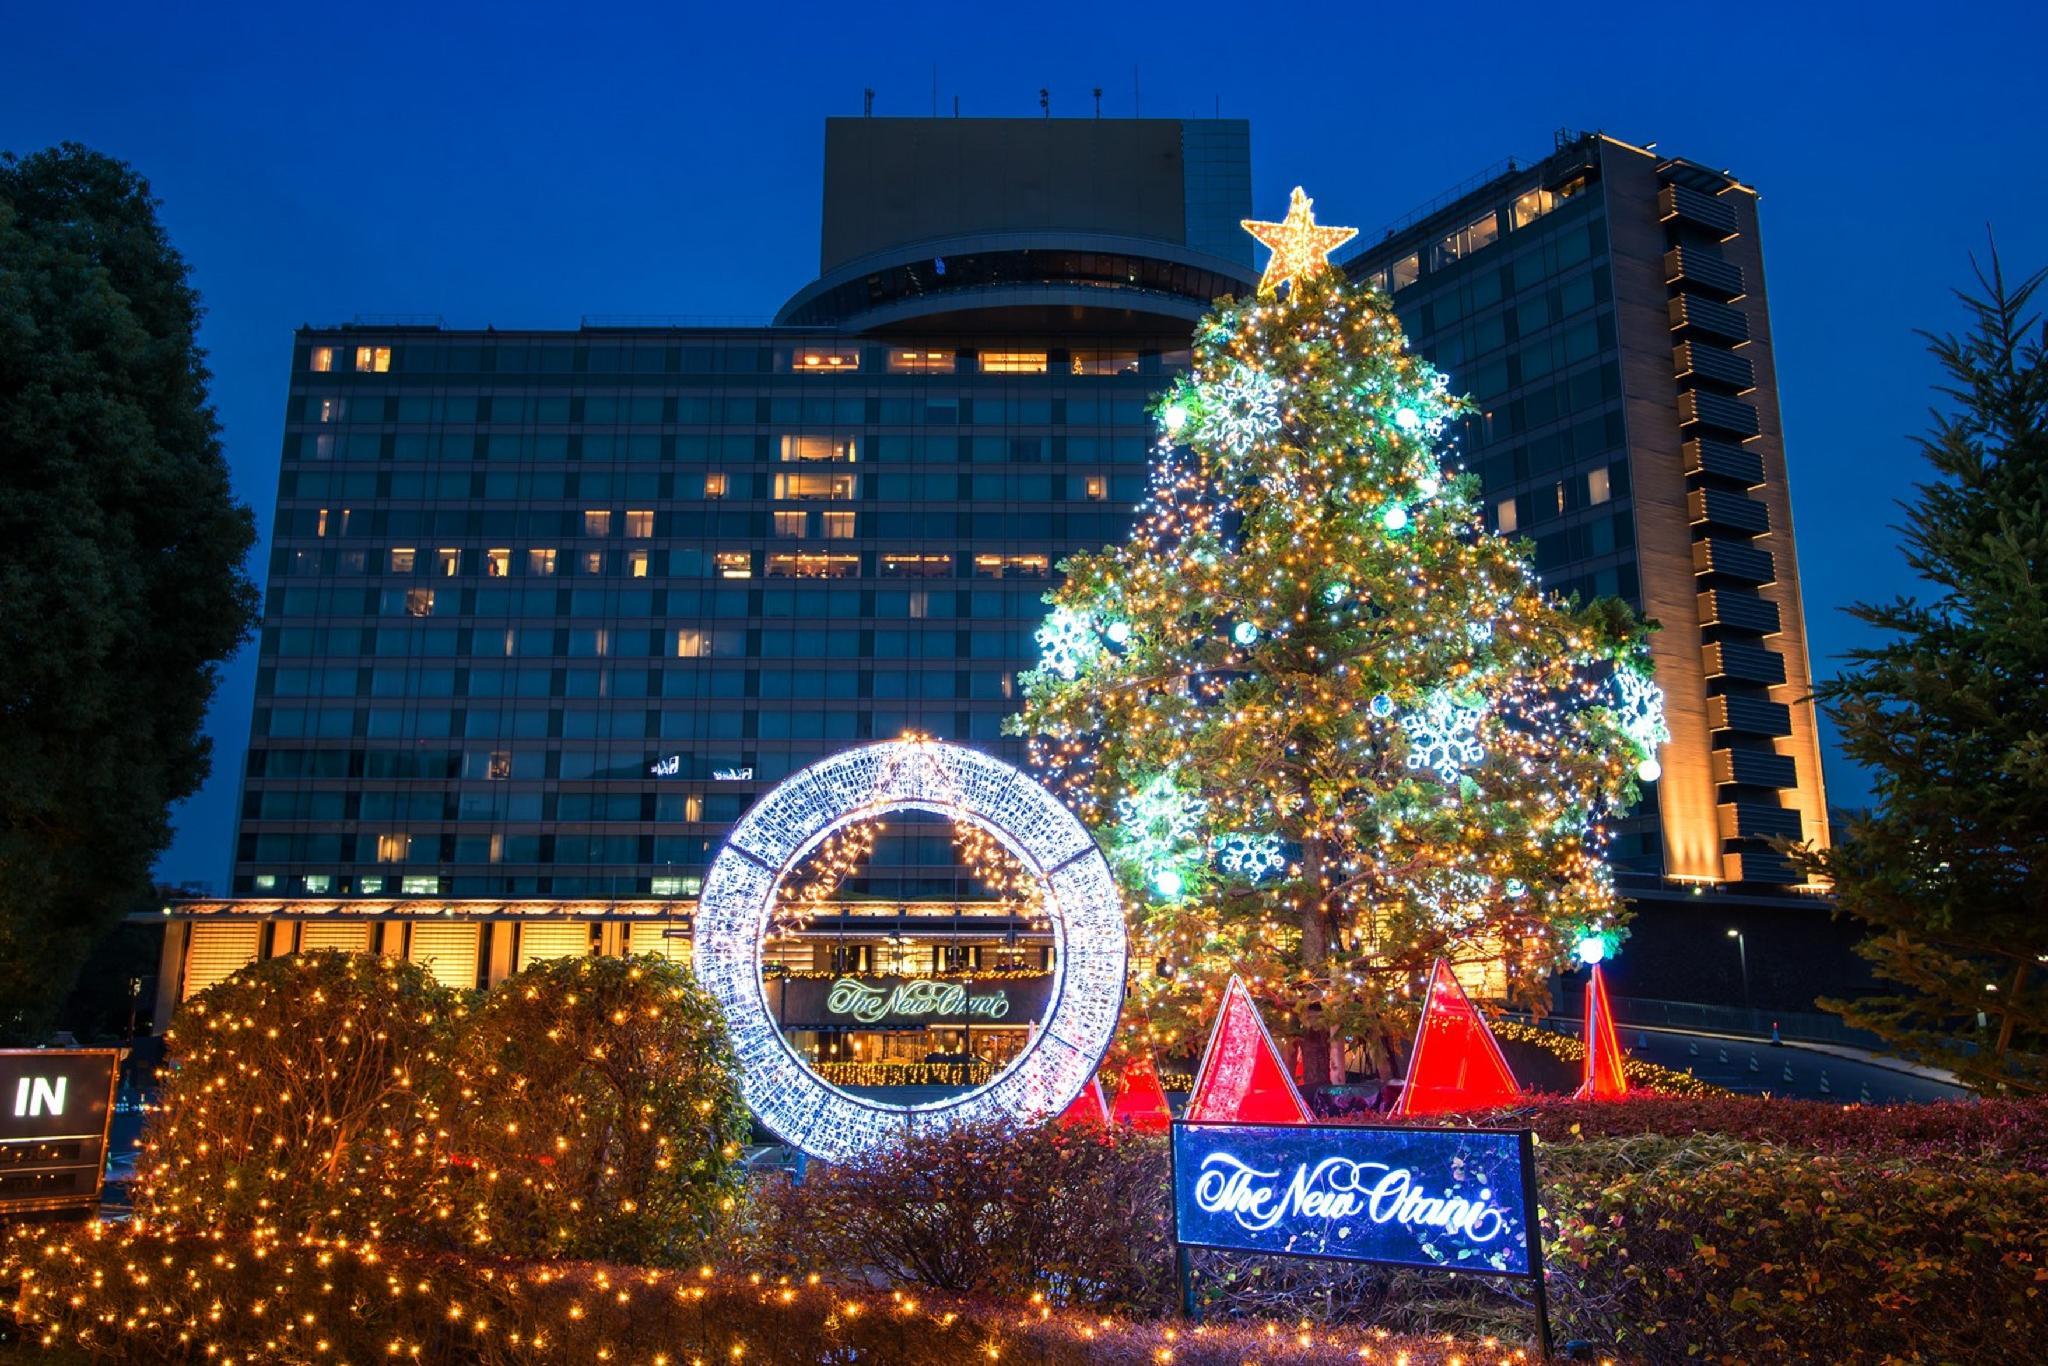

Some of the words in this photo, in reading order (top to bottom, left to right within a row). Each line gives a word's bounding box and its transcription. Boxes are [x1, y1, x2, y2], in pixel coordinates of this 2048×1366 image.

[827, 977, 886, 1016] The
[854, 979, 935, 1023] New
[14, 1076, 67, 1117] IN
[1195, 1152, 1280, 1216] The
[1235, 1156, 1363, 1231] New
[1355, 1162, 1502, 1242] Otani
